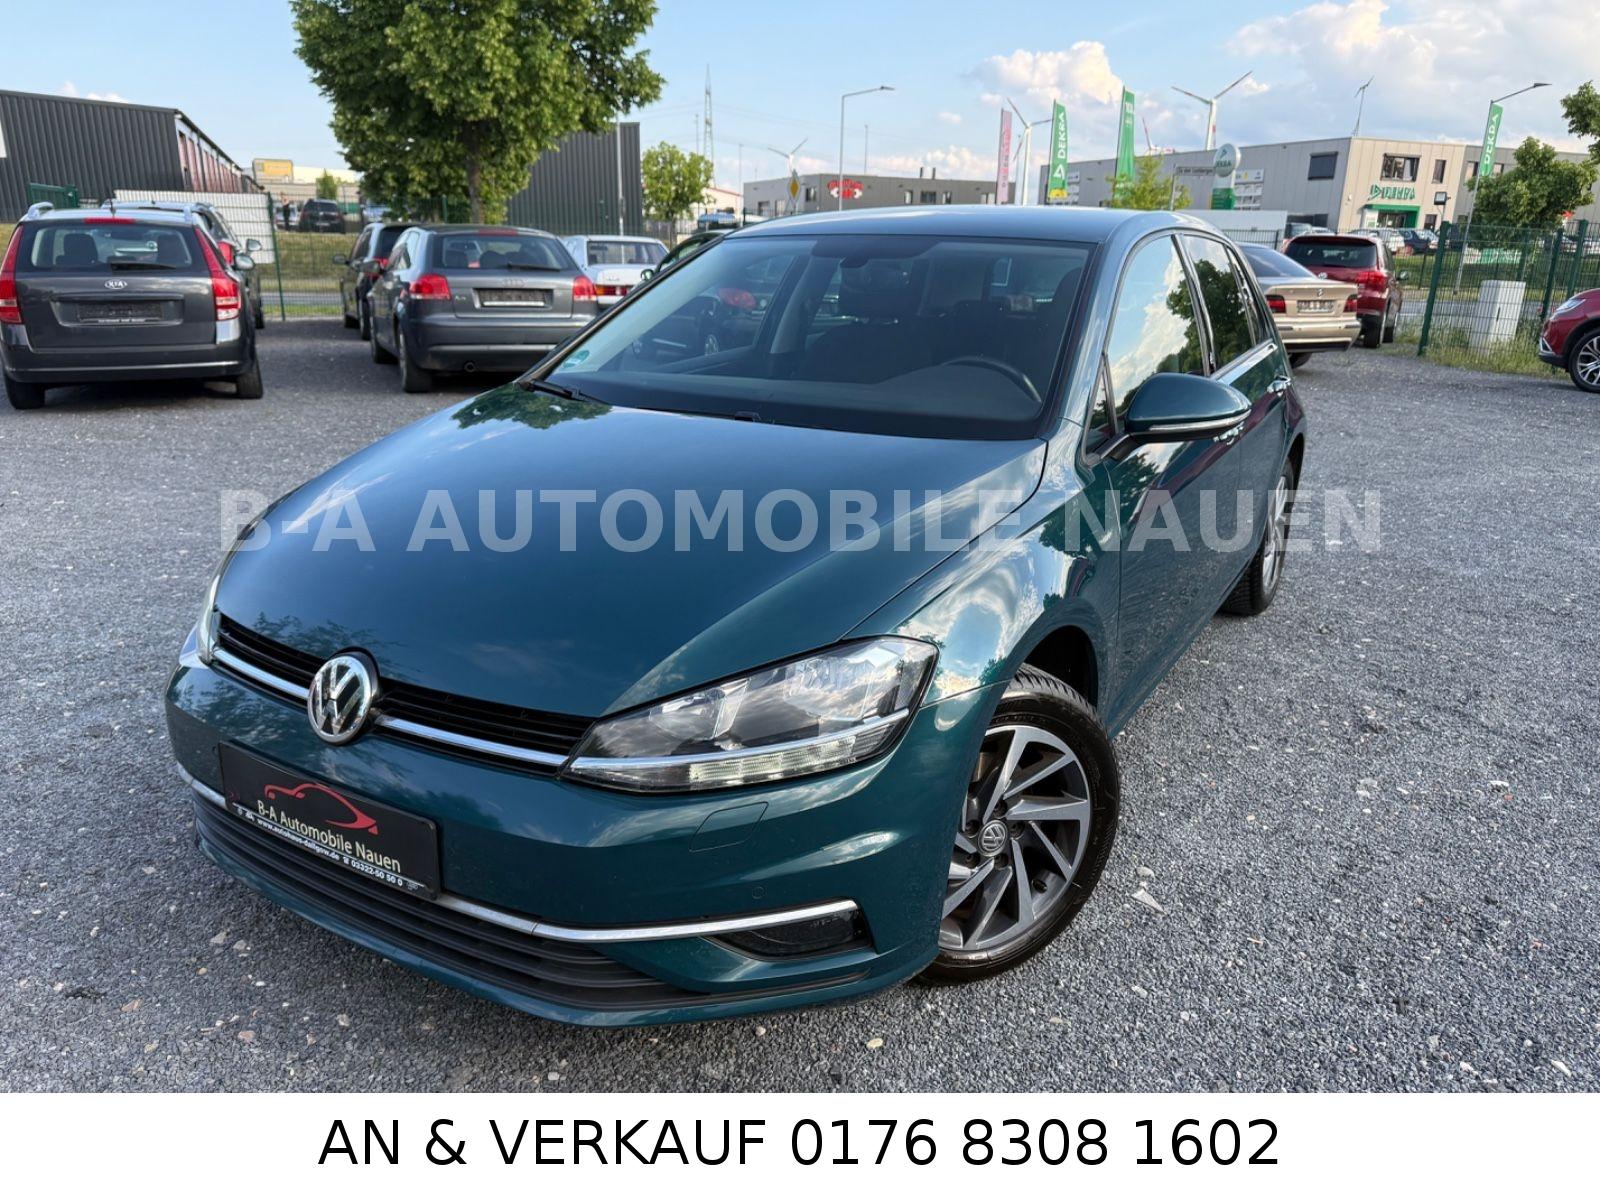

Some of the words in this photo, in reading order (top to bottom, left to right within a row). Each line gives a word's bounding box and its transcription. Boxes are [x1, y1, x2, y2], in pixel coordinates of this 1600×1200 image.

[1056, 111, 1067, 160] DEKRA
[257, 799, 278, 822] B-A
[280, 810, 353, 855] Automobile
[355, 841, 401, 874] Nauen
